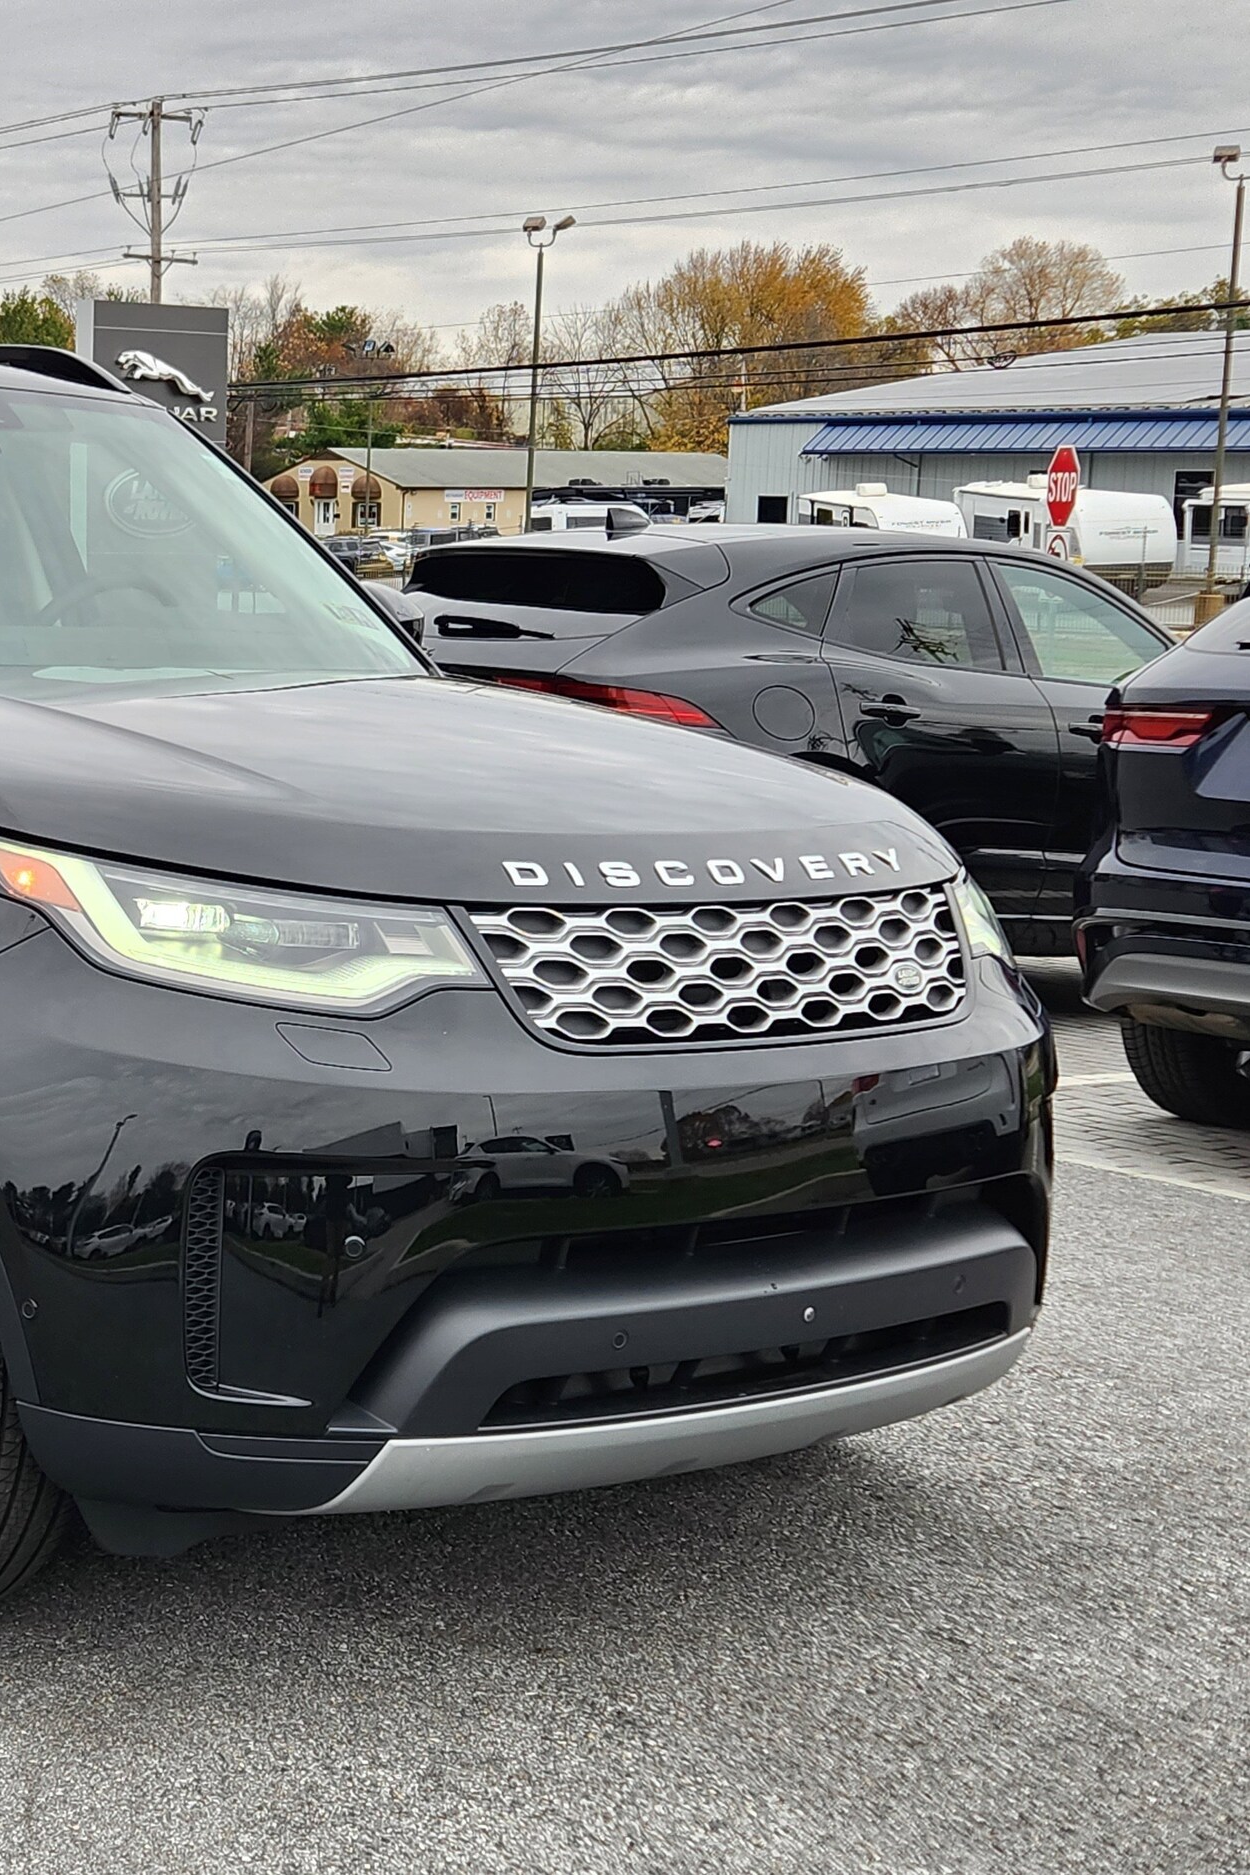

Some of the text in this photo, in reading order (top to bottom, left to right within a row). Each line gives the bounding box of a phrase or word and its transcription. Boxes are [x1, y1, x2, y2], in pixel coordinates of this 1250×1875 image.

[465, 490, 502, 501] EQUIPMENT
[1048, 472, 1078, 503] STOP
[502, 848, 901, 888] DISCOVERY
